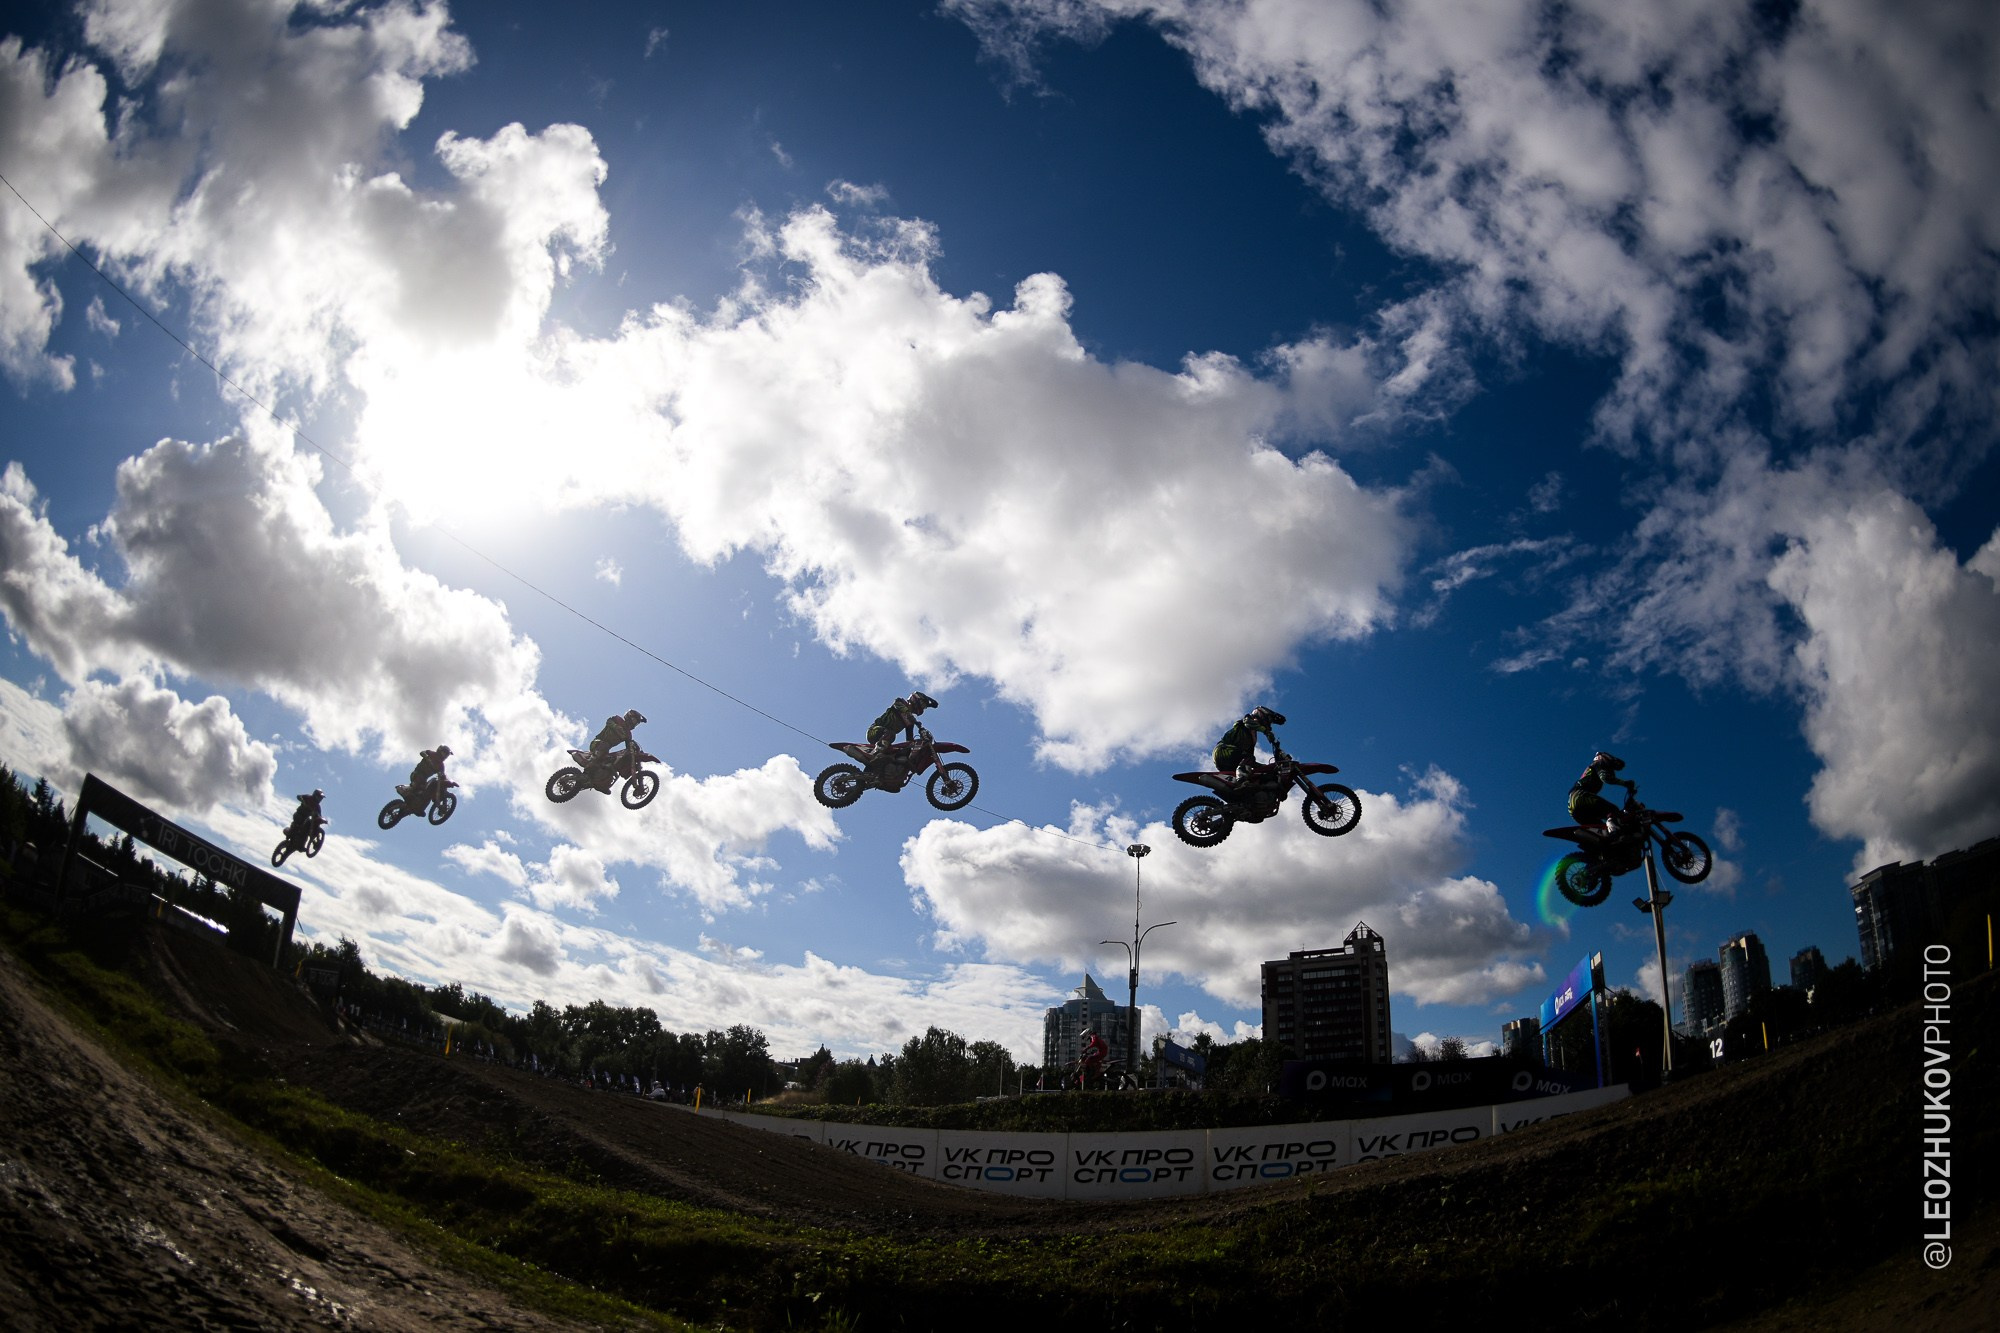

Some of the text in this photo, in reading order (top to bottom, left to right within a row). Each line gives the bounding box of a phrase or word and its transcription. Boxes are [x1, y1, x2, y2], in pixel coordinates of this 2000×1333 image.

[157, 820, 248, 887] TRI TOCHKI
[1709, 1038, 1723, 1058] 12
[1406, 1126, 1480, 1149] ПРО
[865, 1142, 925, 1159] ПРО
[987, 1149, 1055, 1165] ПРО
[1121, 1148, 1195, 1165] ПРО
[1261, 1140, 1337, 1160] ПРО
[943, 1165, 1054, 1183] СПОРТ
[1074, 1166, 1194, 1184] СПОРТ
[1212, 1159, 1337, 1181] СПОРТ
